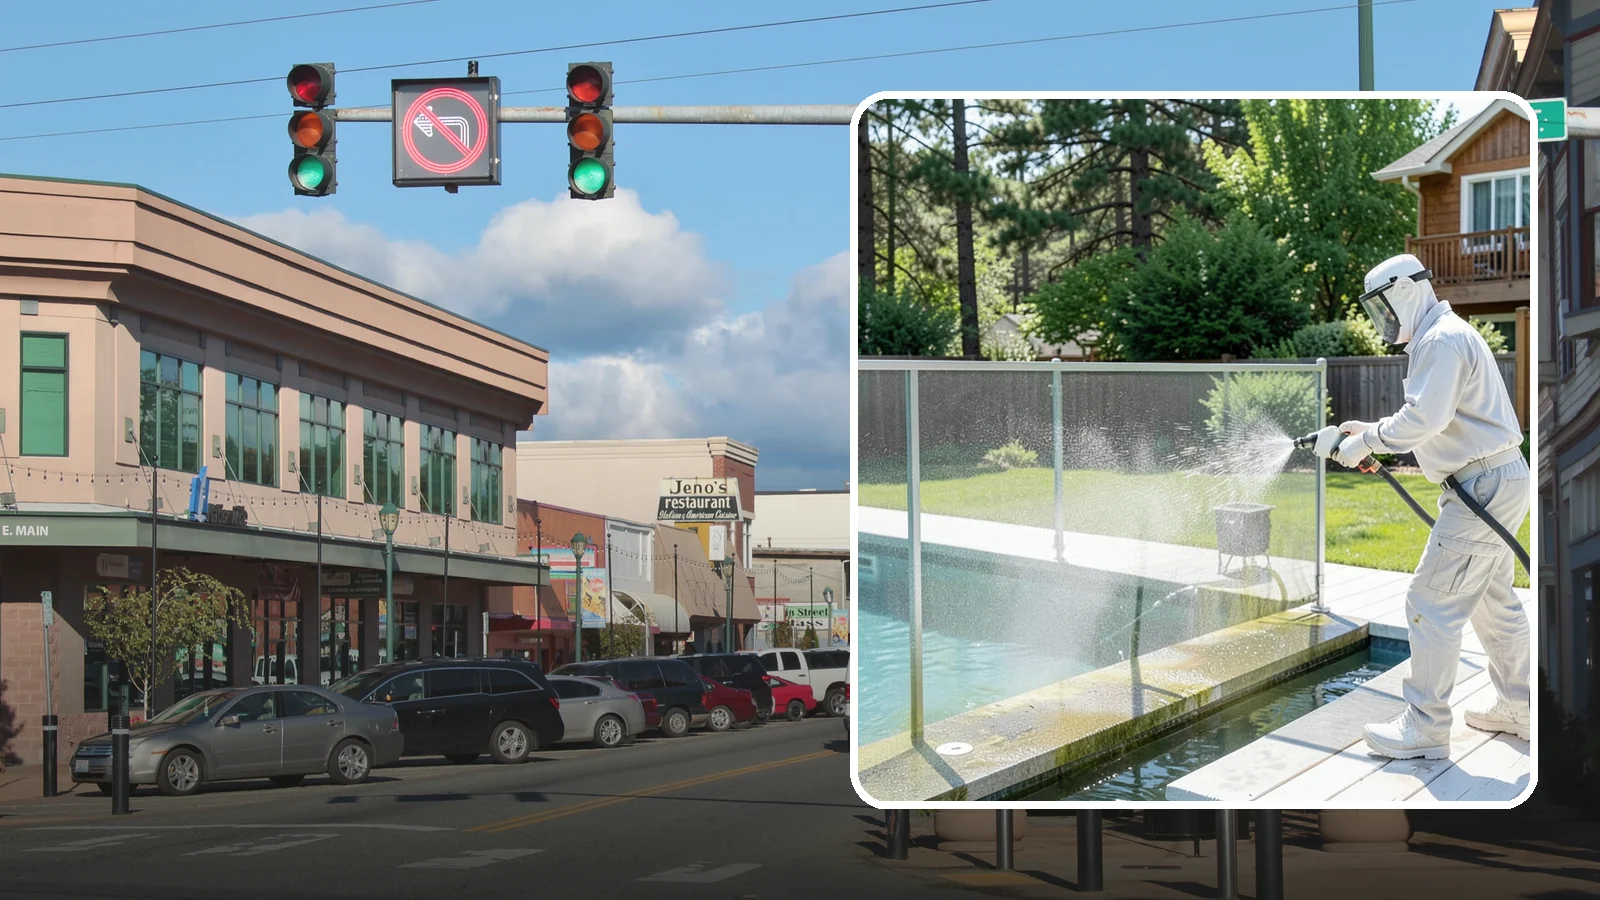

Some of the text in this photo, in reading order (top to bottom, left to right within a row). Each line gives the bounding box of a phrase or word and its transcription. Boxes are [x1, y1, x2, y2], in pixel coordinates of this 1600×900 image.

[669, 480, 727, 494] Jeno's
[665, 496, 731, 509] restaurant
[659, 510, 681, 519] Italian
[686, 510, 715, 519] American
[715, 510, 737, 519] Cuisine
[2, 525, 49, 536] E. MAIN
[786, 607, 829, 617] in Street
[791, 619, 823, 627] lass
